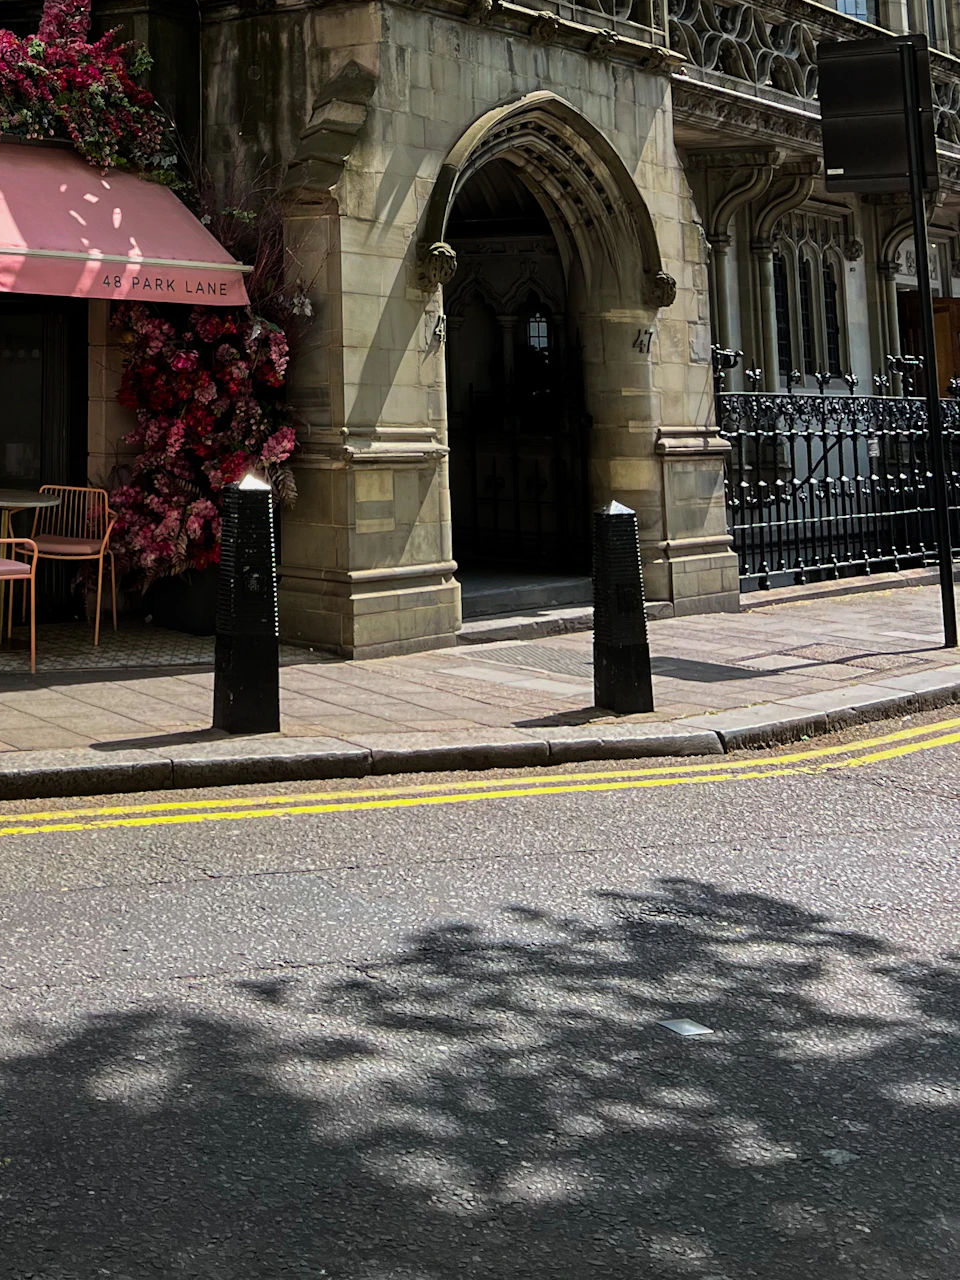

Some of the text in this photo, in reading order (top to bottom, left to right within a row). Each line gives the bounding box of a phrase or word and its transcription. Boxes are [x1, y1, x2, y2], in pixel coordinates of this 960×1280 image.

[102, 274, 228, 296] 48 PARK LANE
[632, 328, 654, 354] 47
